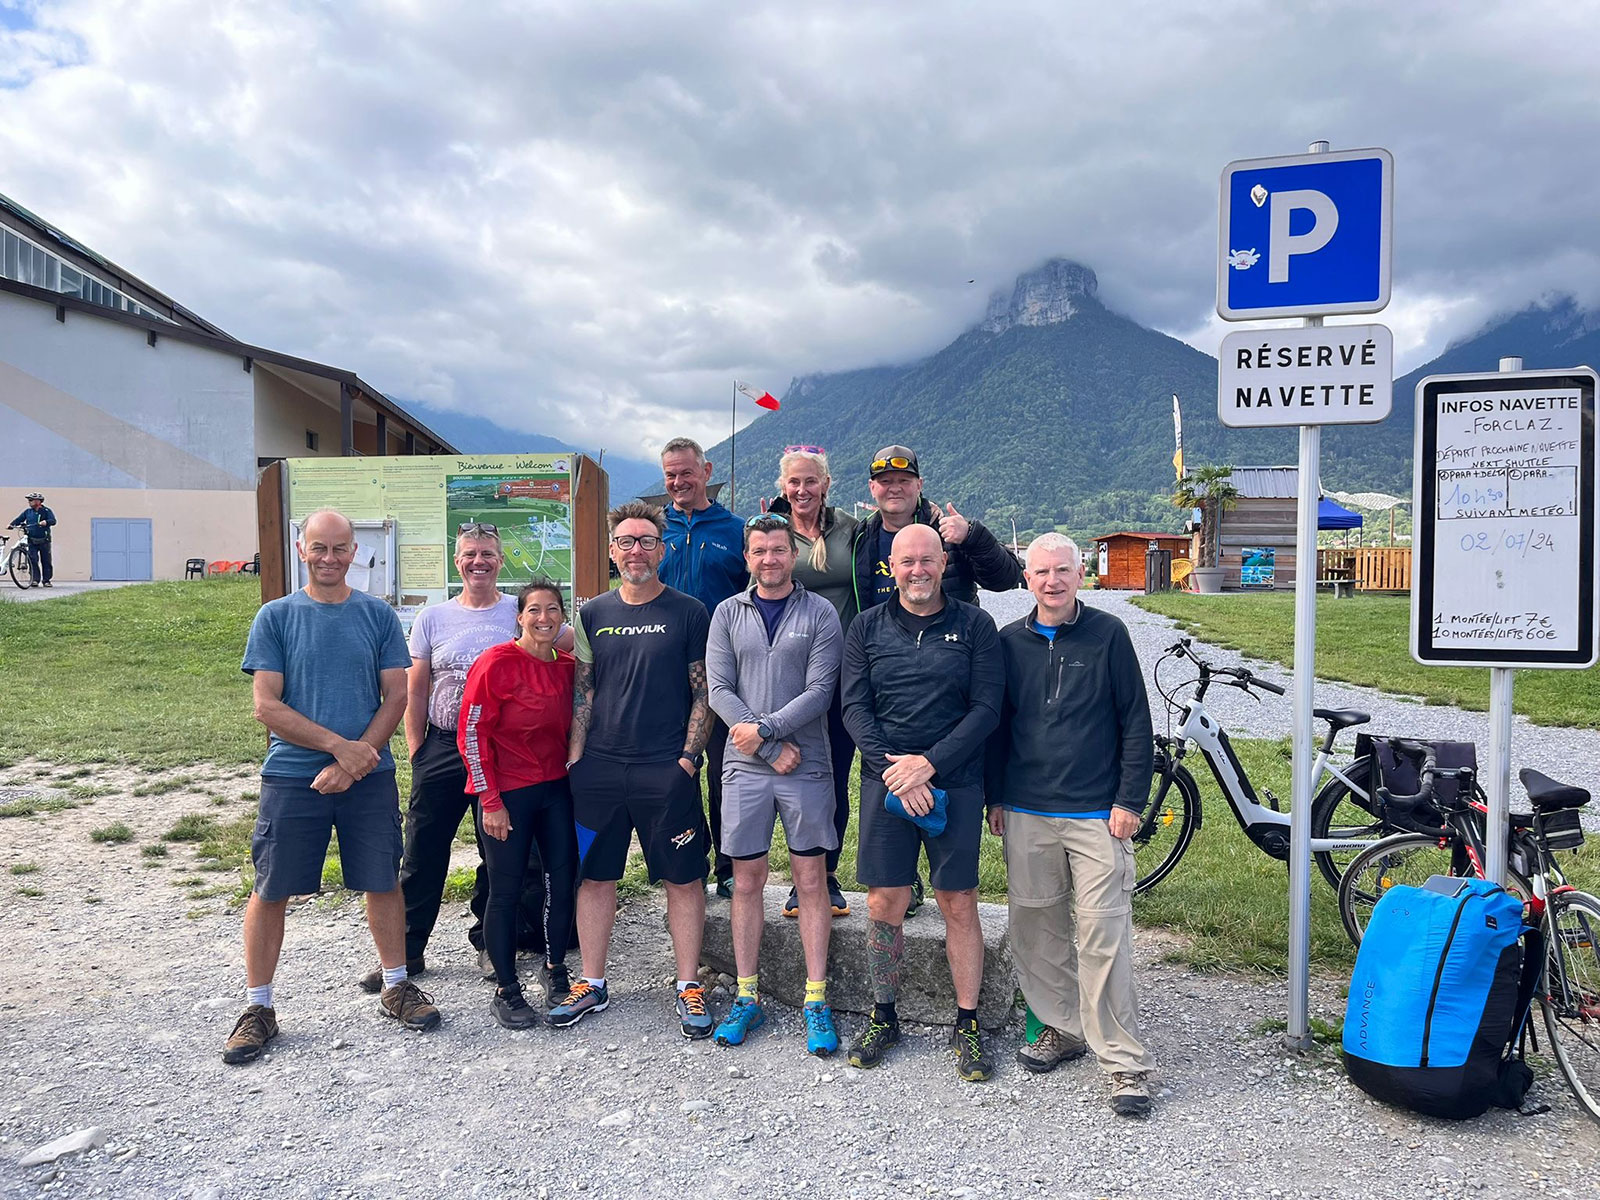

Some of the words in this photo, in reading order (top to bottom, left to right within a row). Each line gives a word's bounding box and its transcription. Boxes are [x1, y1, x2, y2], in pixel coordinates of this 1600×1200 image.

[1268, 188, 1339, 284] P
[1236, 338, 1377, 369] RÉSERVÉ
[1235, 384, 1375, 408] NAVETTE
[1441, 399, 1494, 414] INFOS
[1499, 396, 1578, 411] NAVETTE
[1436, 445, 1477, 463] DÉPART
[1481, 443, 1530, 457] PROCHAINE
[1530, 440, 1579, 454] NAVETTE
[457, 461, 504, 472] Bienvenue
[516, 460, 553, 469] Welcom
[1471, 459, 1503, 468] NEXT
[1504, 457, 1554, 467] SHUTTLE
[621, 624, 667, 635] NIVIUK
[1432, 627, 1450, 638] 10
[1526, 627, 1558, 640] 60€
[454, 669, 467, 680] TR
[1360, 981, 1376, 1051] ADVANCE
